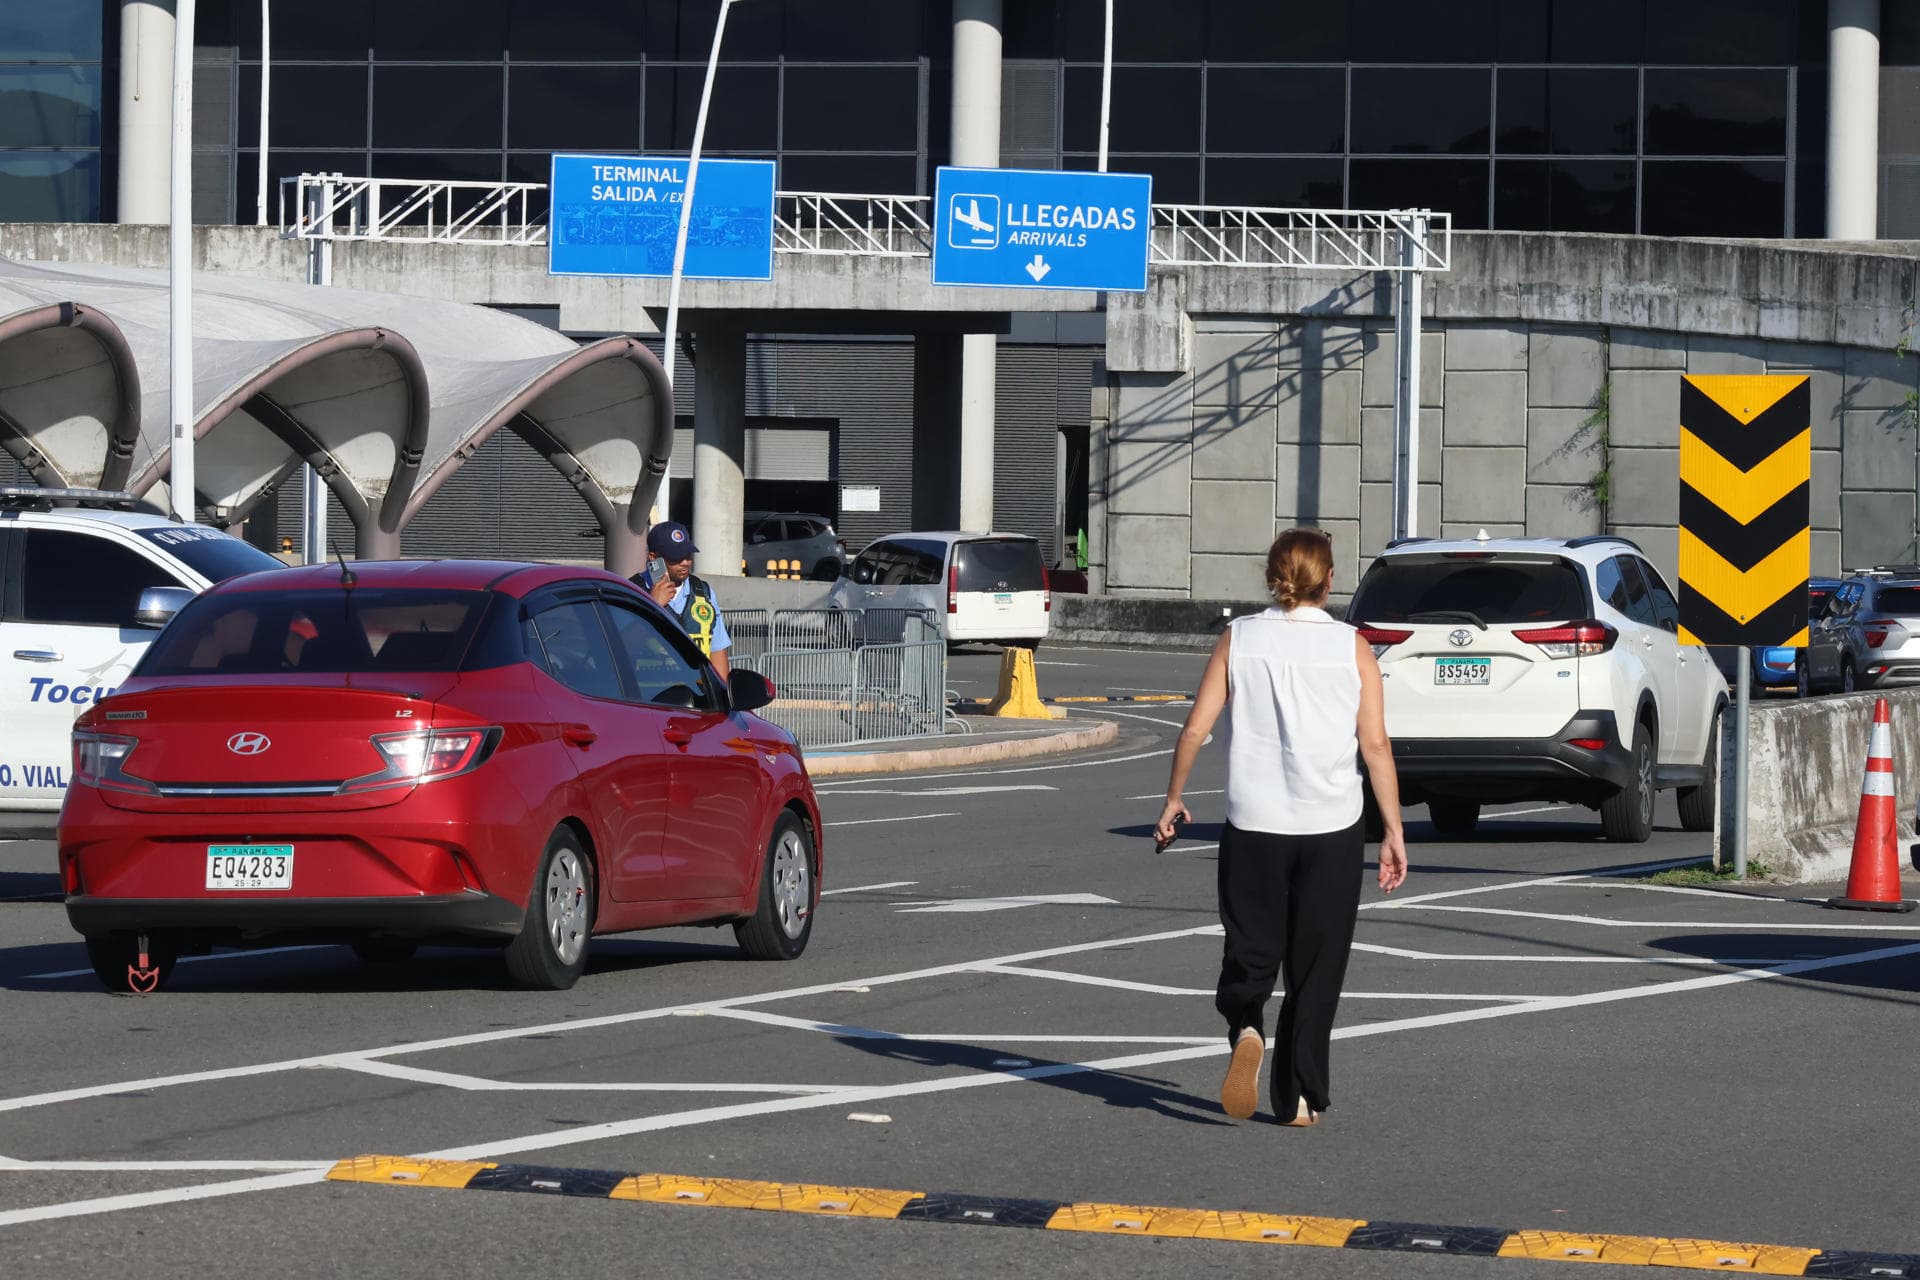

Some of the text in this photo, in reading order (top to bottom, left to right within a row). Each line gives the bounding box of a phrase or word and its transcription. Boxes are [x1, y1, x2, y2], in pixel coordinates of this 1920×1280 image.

[592, 165, 684, 184] TERMINAL
[591, 185, 657, 202] SALIDA
[1007, 203, 1136, 231] LLEGADAS
[1007, 231, 1087, 247] ARRIVALS
[1439, 665, 1487, 678] BS5459
[22, 765, 68, 788] VIAL
[232, 848, 268, 856] PANAMA
[212, 857, 286, 878] EQ4283
